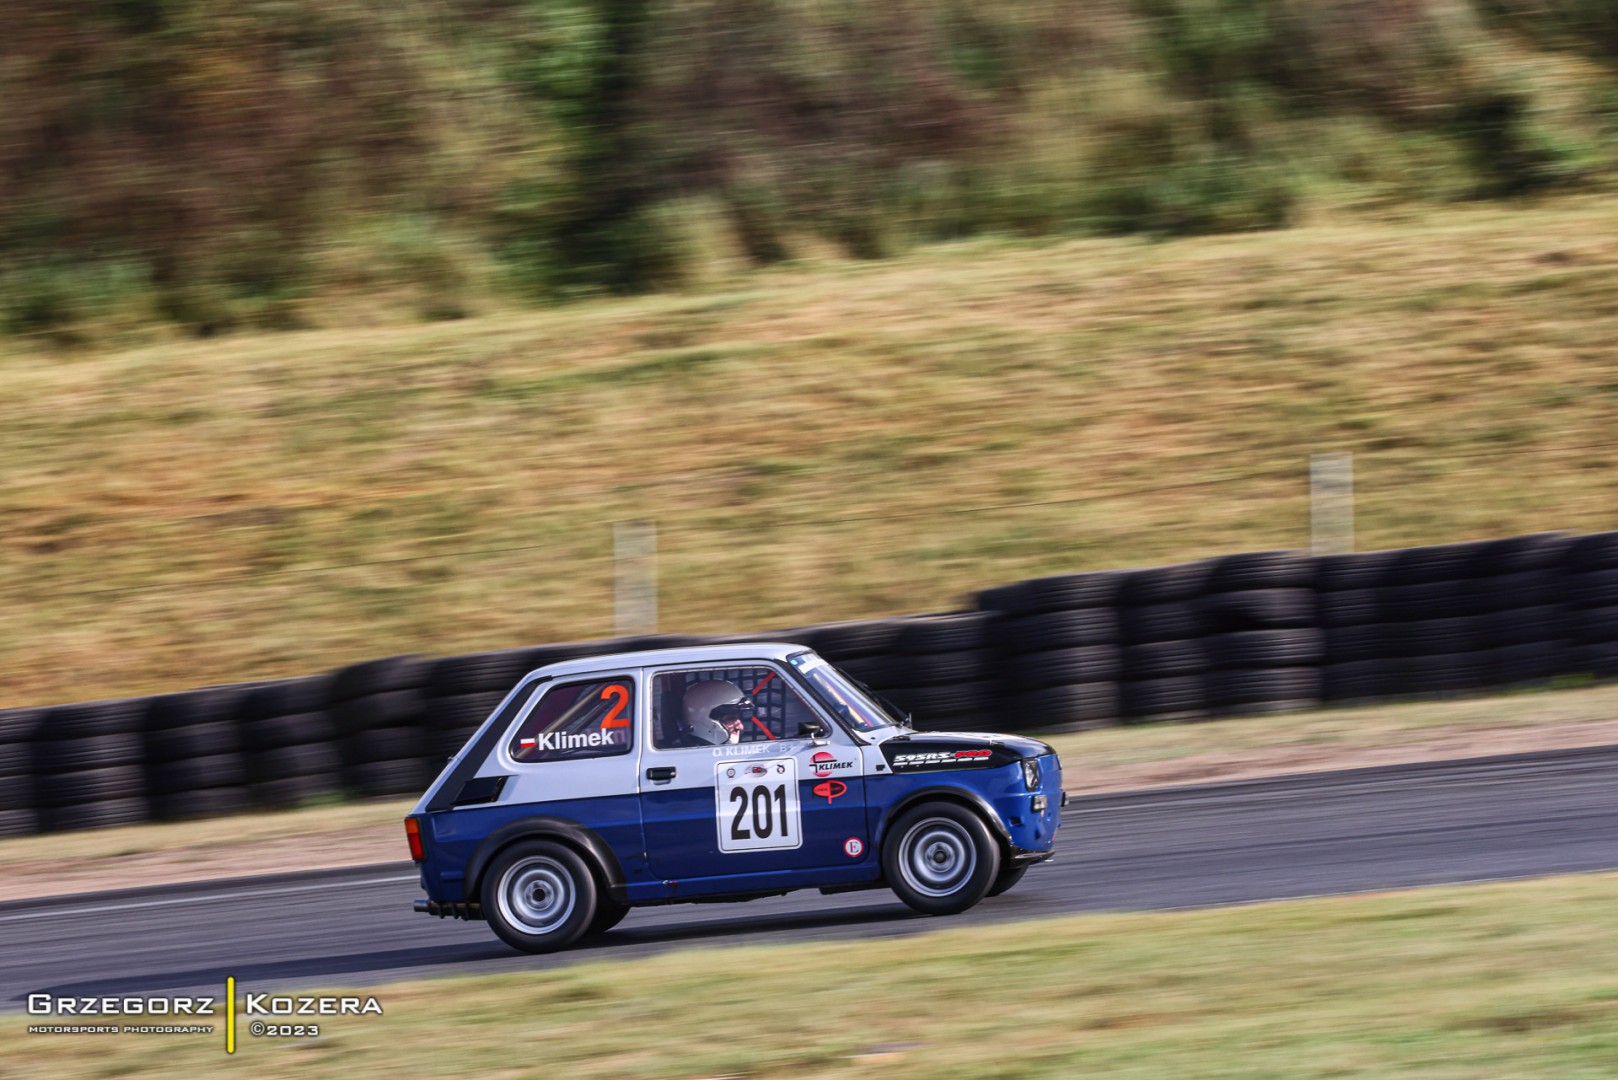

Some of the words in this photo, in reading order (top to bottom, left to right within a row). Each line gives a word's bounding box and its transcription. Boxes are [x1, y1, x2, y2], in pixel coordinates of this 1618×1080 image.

[600, 684, 631, 728] 2
[538, 728, 614, 751] Klimek
[726, 744, 770, 756] KLIMEK
[818, 761, 854, 771] KLIMEK
[729, 784, 788, 840] 201
[849, 841, 859, 855] E
